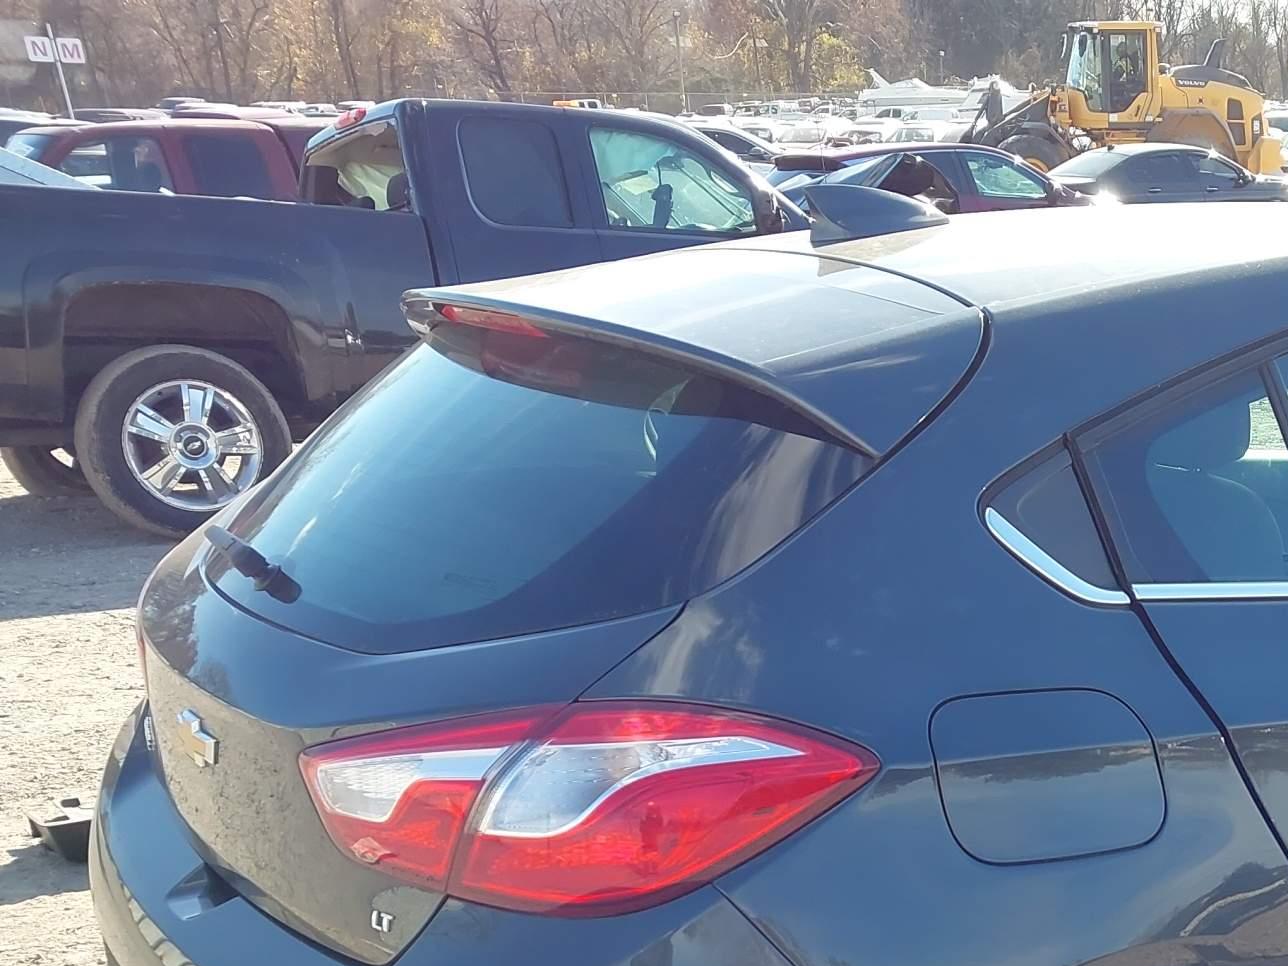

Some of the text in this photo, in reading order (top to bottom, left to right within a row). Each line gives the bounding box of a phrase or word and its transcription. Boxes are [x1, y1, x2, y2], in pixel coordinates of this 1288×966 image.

[31, 40, 49, 57] N
[61, 43, 82, 59] M
[371, 910, 394, 933] LT
